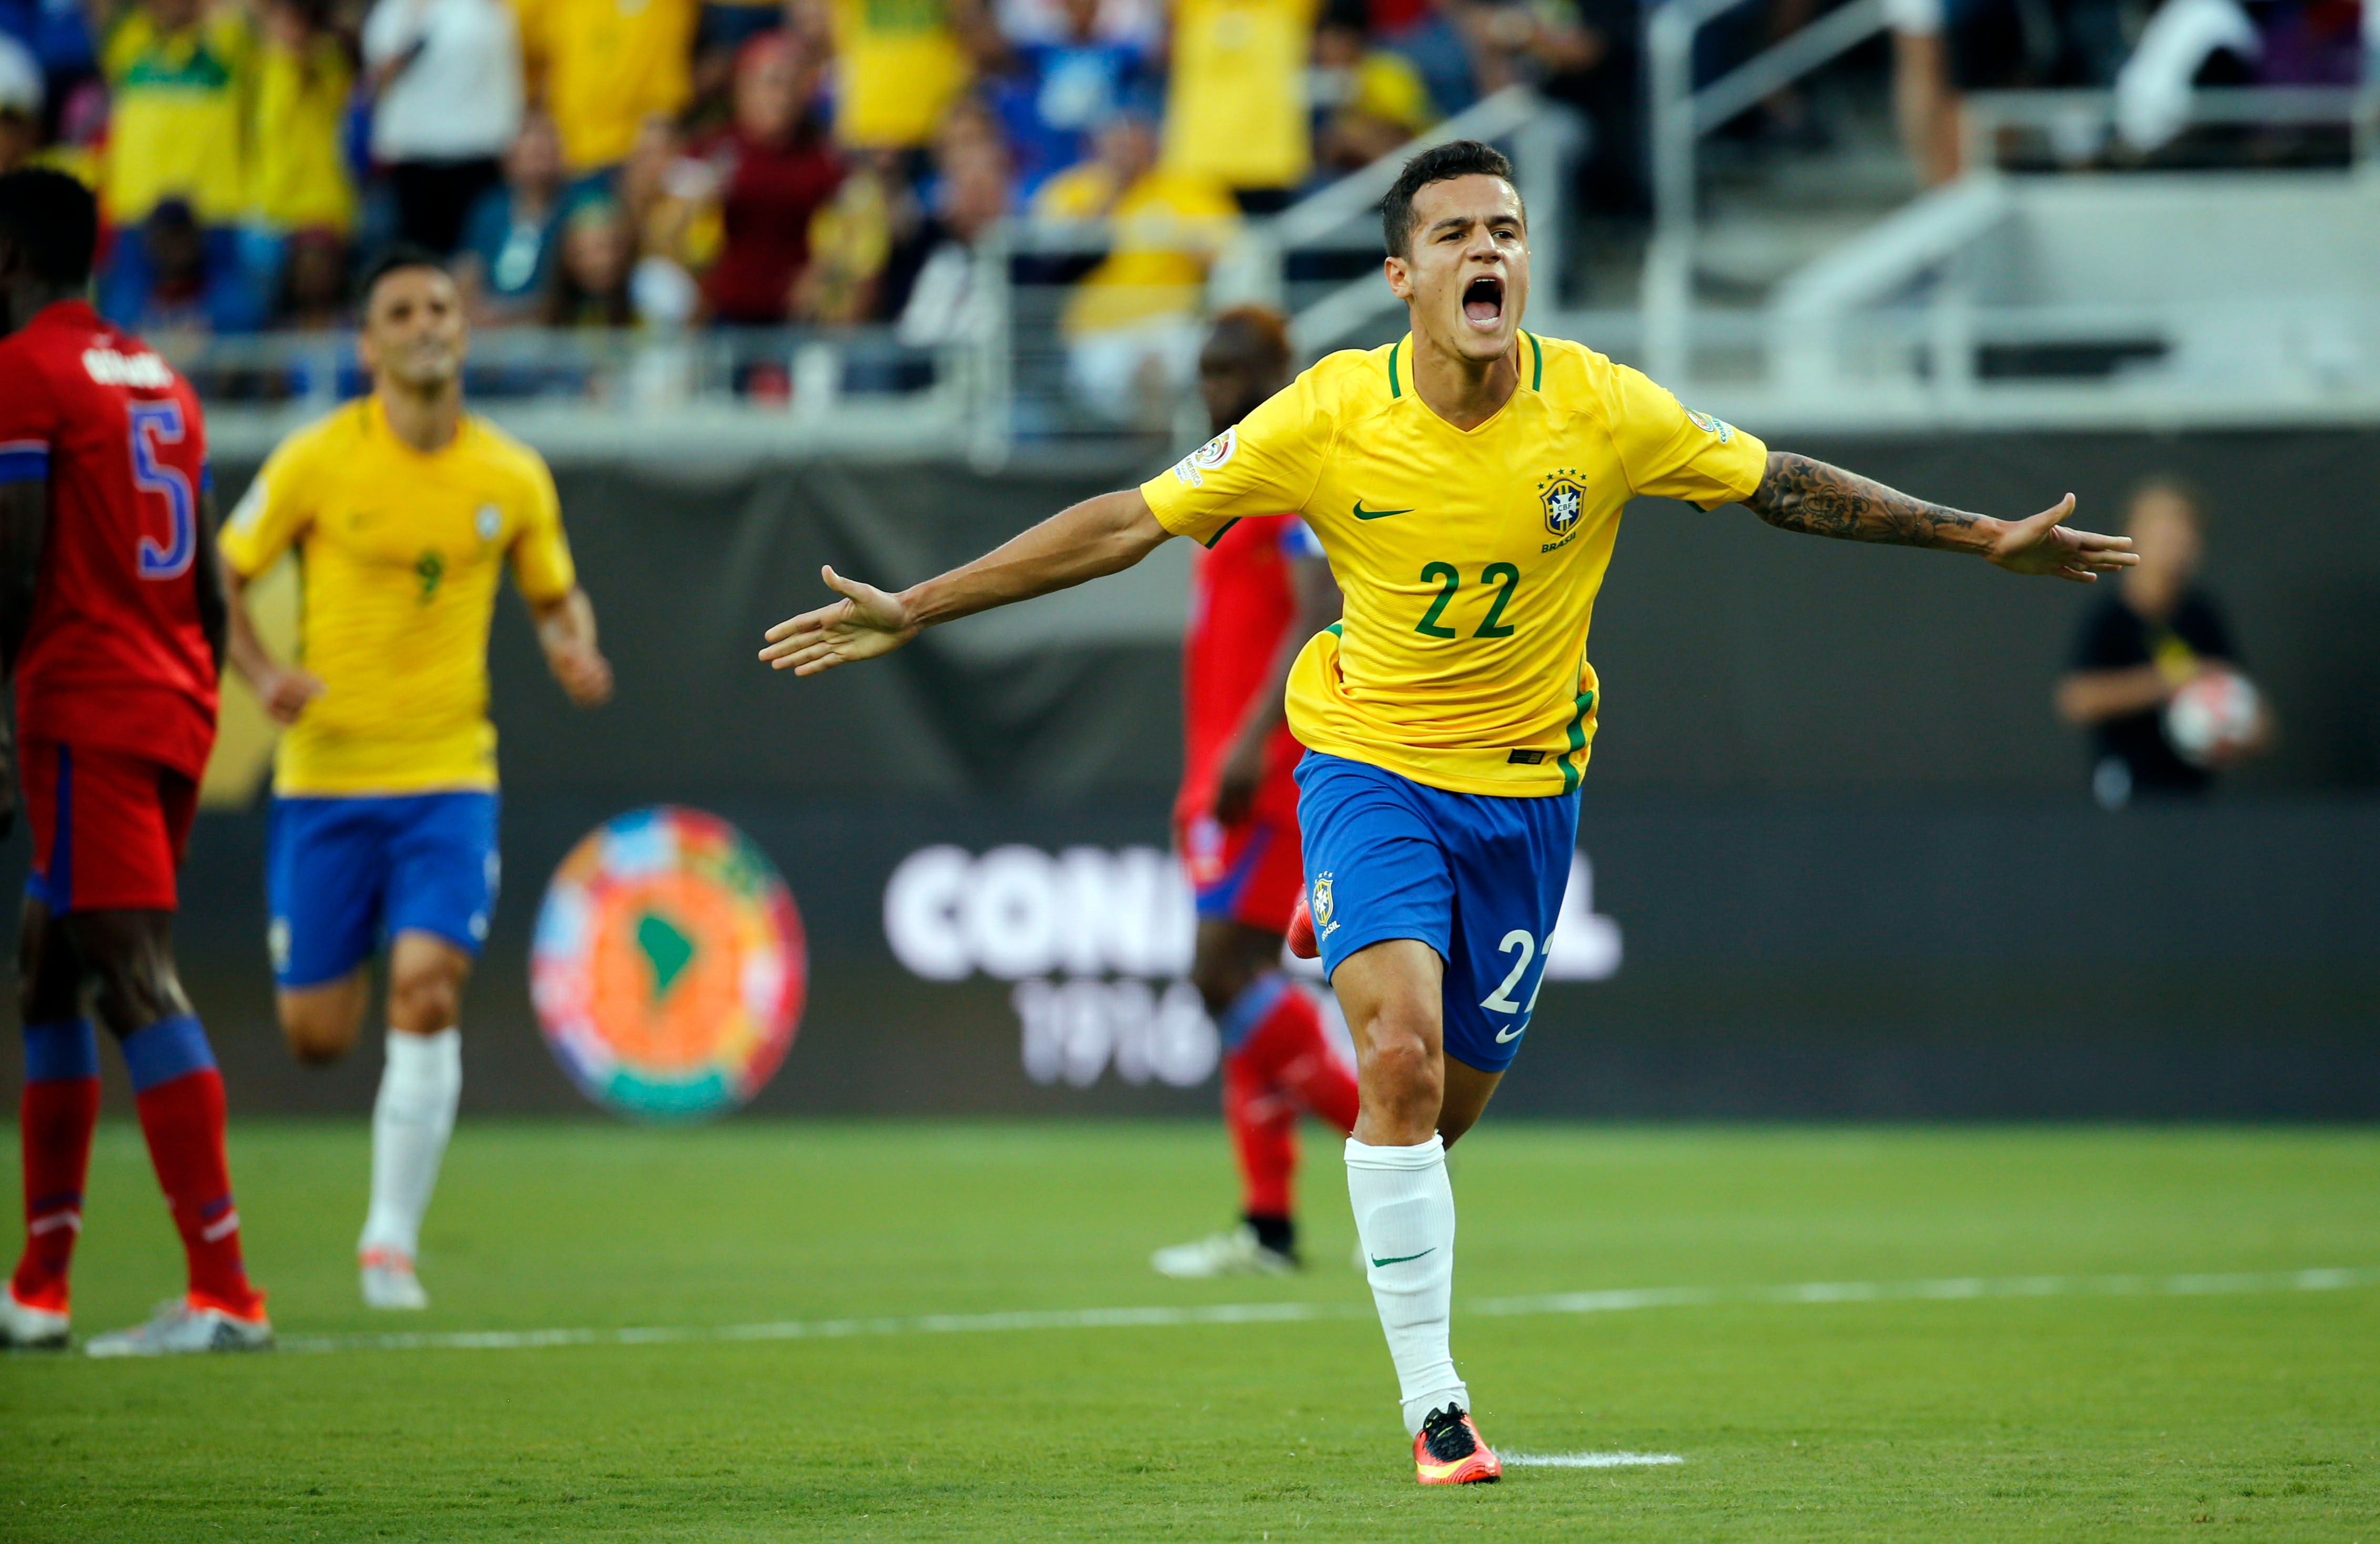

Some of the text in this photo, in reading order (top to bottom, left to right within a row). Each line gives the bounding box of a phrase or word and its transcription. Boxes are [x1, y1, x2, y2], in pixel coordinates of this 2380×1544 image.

[128, 399, 196, 580] 5
[1558, 503, 1572, 511] CBF
[416, 551, 443, 605] 9
[1414, 561, 1520, 638] 22
[1479, 929, 1555, 1014] 2
